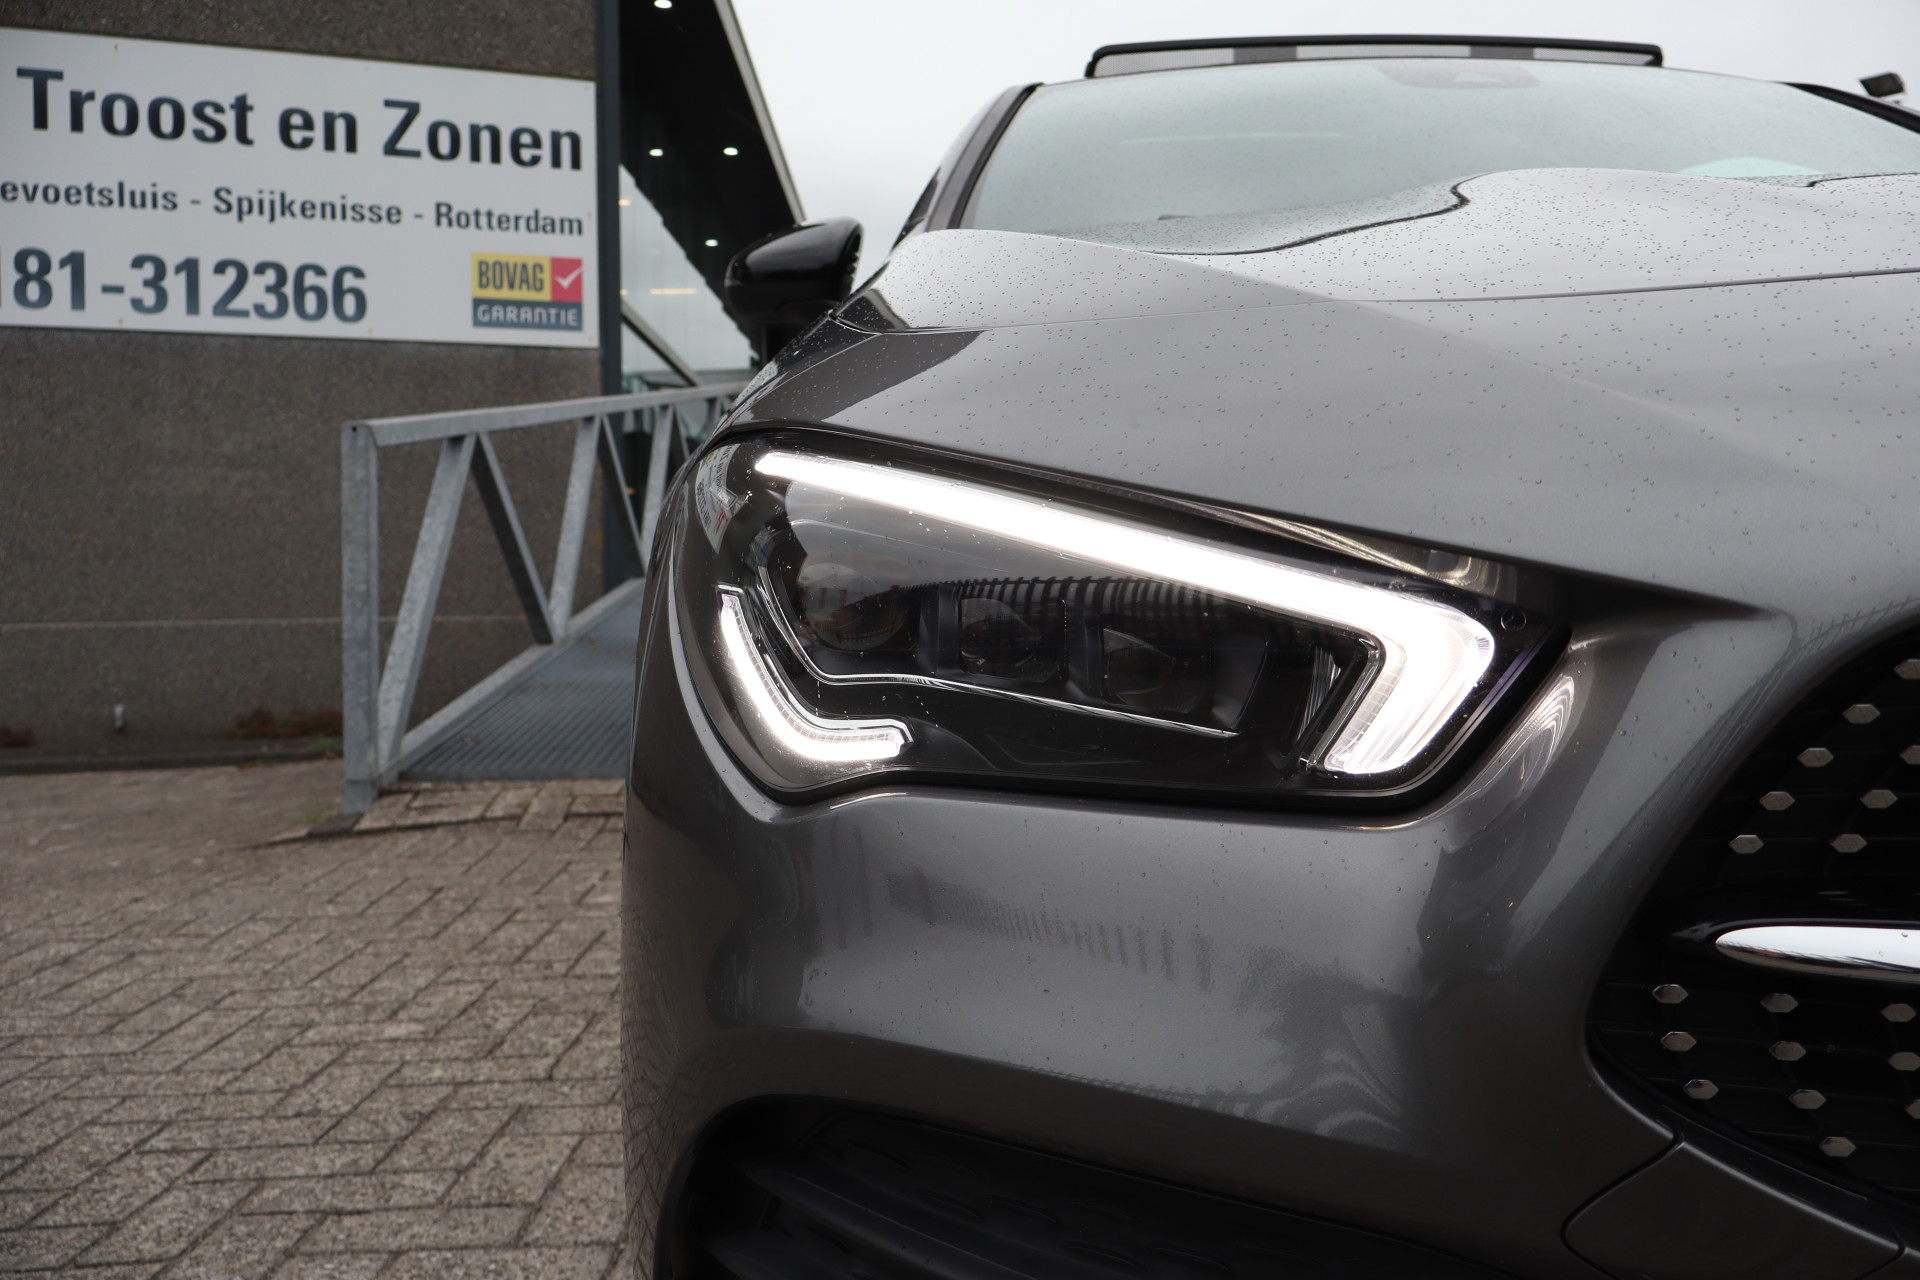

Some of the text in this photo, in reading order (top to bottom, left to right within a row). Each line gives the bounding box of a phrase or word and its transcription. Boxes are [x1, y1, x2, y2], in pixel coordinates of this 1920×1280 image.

[16, 66, 582, 172] Troost en Zonen
[0, 180, 179, 212] evoetsluis
[213, 186, 402, 225] Spijkenisse
[435, 202, 583, 237] Rotterdam
[0, 246, 368, 324] 81-312366
[477, 260, 545, 293] BOVAG
[477, 303, 579, 326] GARANTIE
